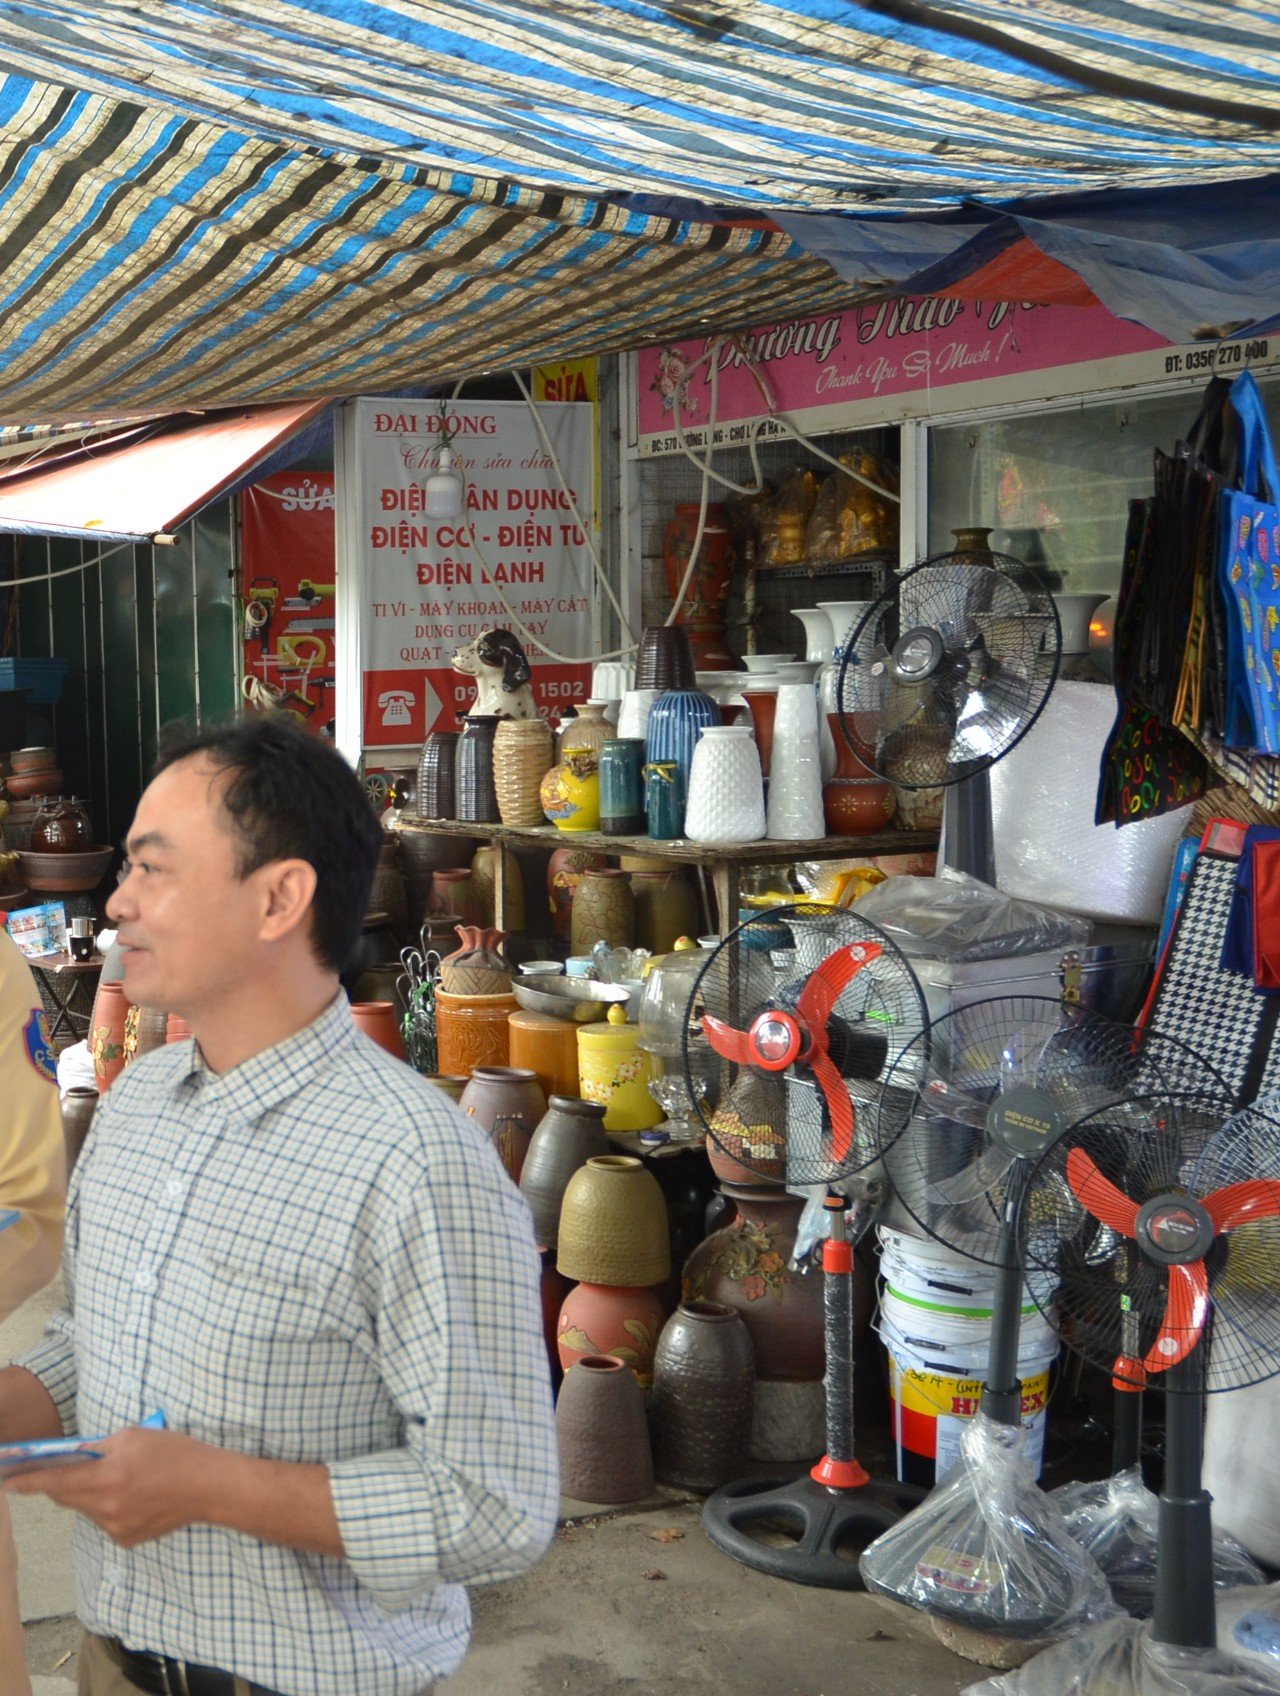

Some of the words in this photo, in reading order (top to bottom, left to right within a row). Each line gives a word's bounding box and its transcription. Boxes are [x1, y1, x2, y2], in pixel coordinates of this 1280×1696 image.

[816, 365, 863, 394] Thank
[936, 342, 990, 374] Much
[1186, 349, 1217, 370] 0356
[1218, 345, 1241, 365] 270
[664, 437, 677, 450] 570
[483, 452, 512, 469] sửa
[380, 483, 427, 517] ĐIỆ
[466, 483, 498, 511] ÂN
[507, 488, 577, 516] DỤNG
[371, 520, 429, 554] ĐIỆN
[436, 522, 476, 548] CƠ
[498, 519, 552, 553] ĐIỆN
[416, 557, 472, 591] ĐIỆN
[372, 603, 387, 617] TI
[540, 681, 584, 697] 1502
